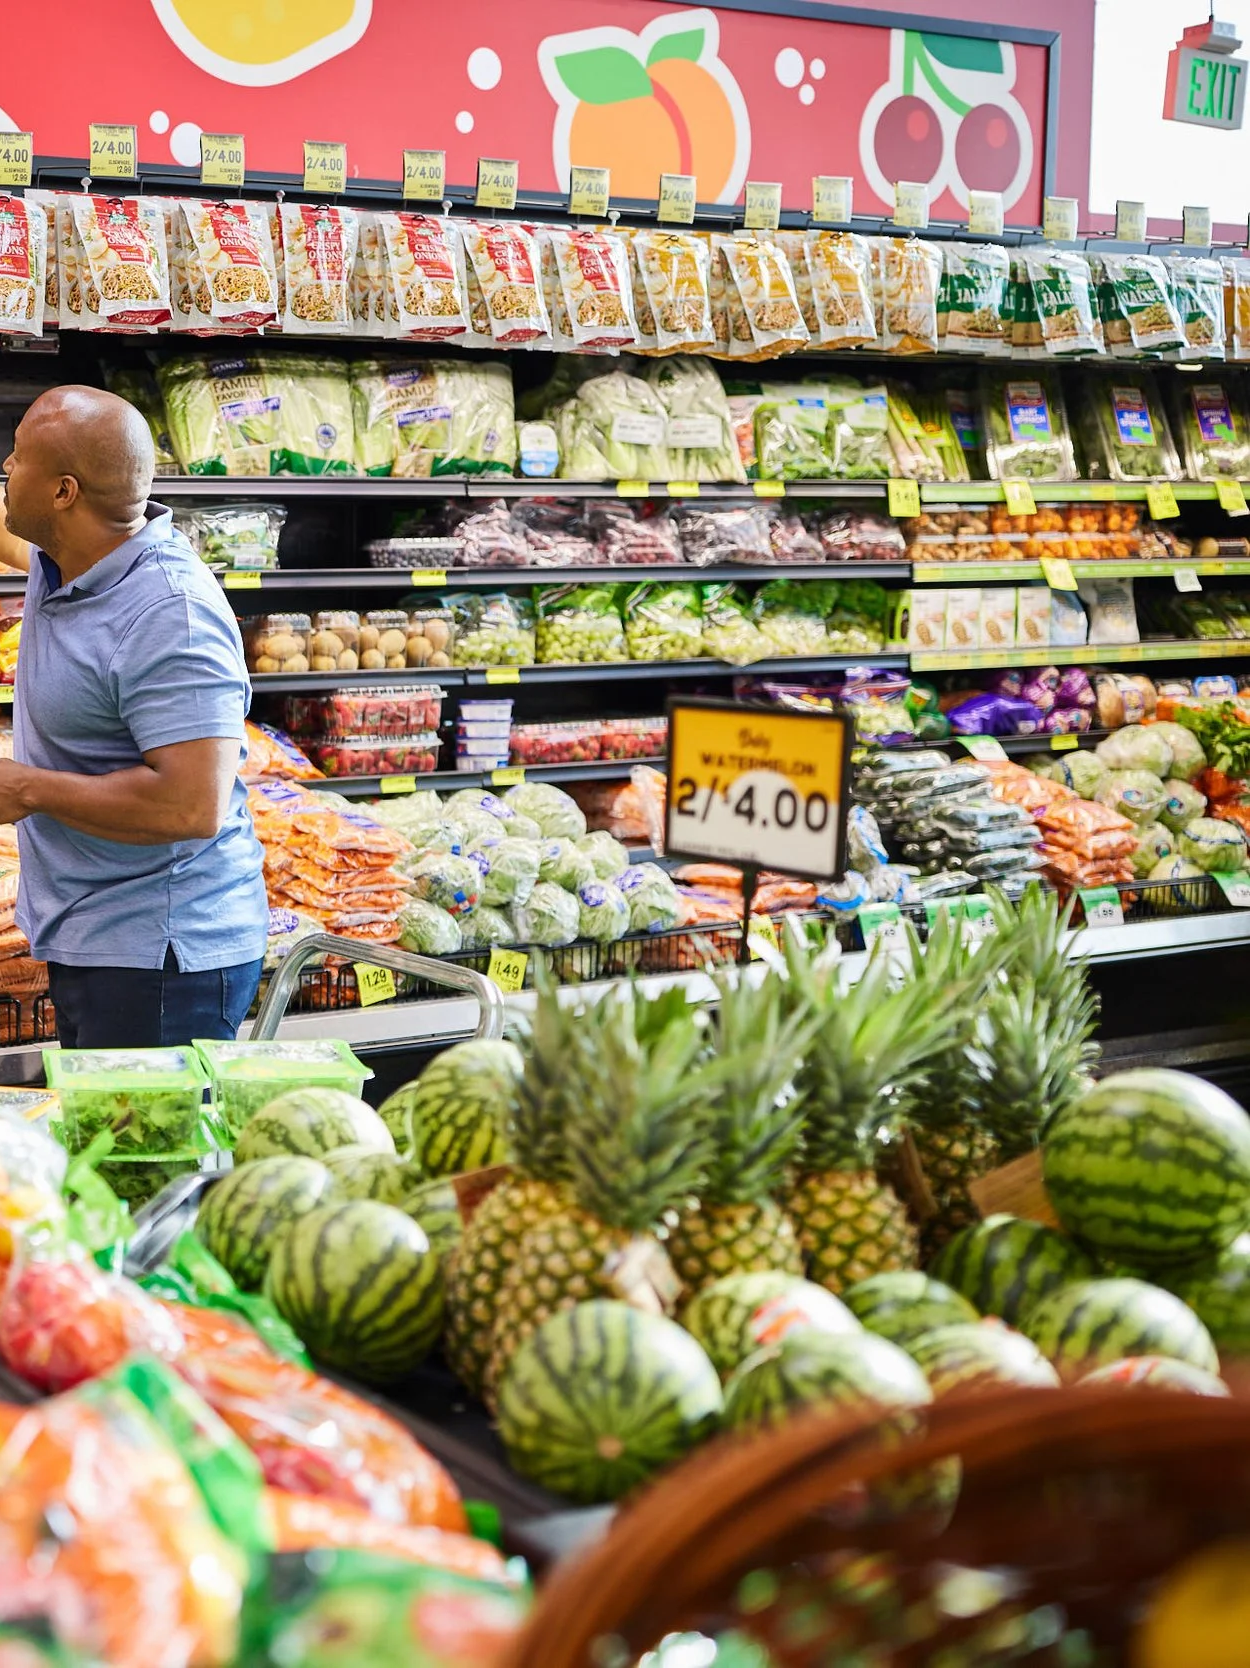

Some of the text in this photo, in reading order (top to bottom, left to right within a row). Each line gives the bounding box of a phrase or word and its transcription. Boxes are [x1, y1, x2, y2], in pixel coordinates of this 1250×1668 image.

[1187, 57, 1241, 120] EXIT
[92, 141, 132, 155] 2/4.00
[204, 150, 241, 163] 2/4.00
[307, 157, 342, 171] 2/4.00
[406, 165, 441, 179] 2/4.00
[481, 173, 515, 188] 2/4.00
[573, 181, 606, 194] 2/4.00
[213, 375, 261, 393] FAMILY
[700, 753, 817, 778] WATERMELON
